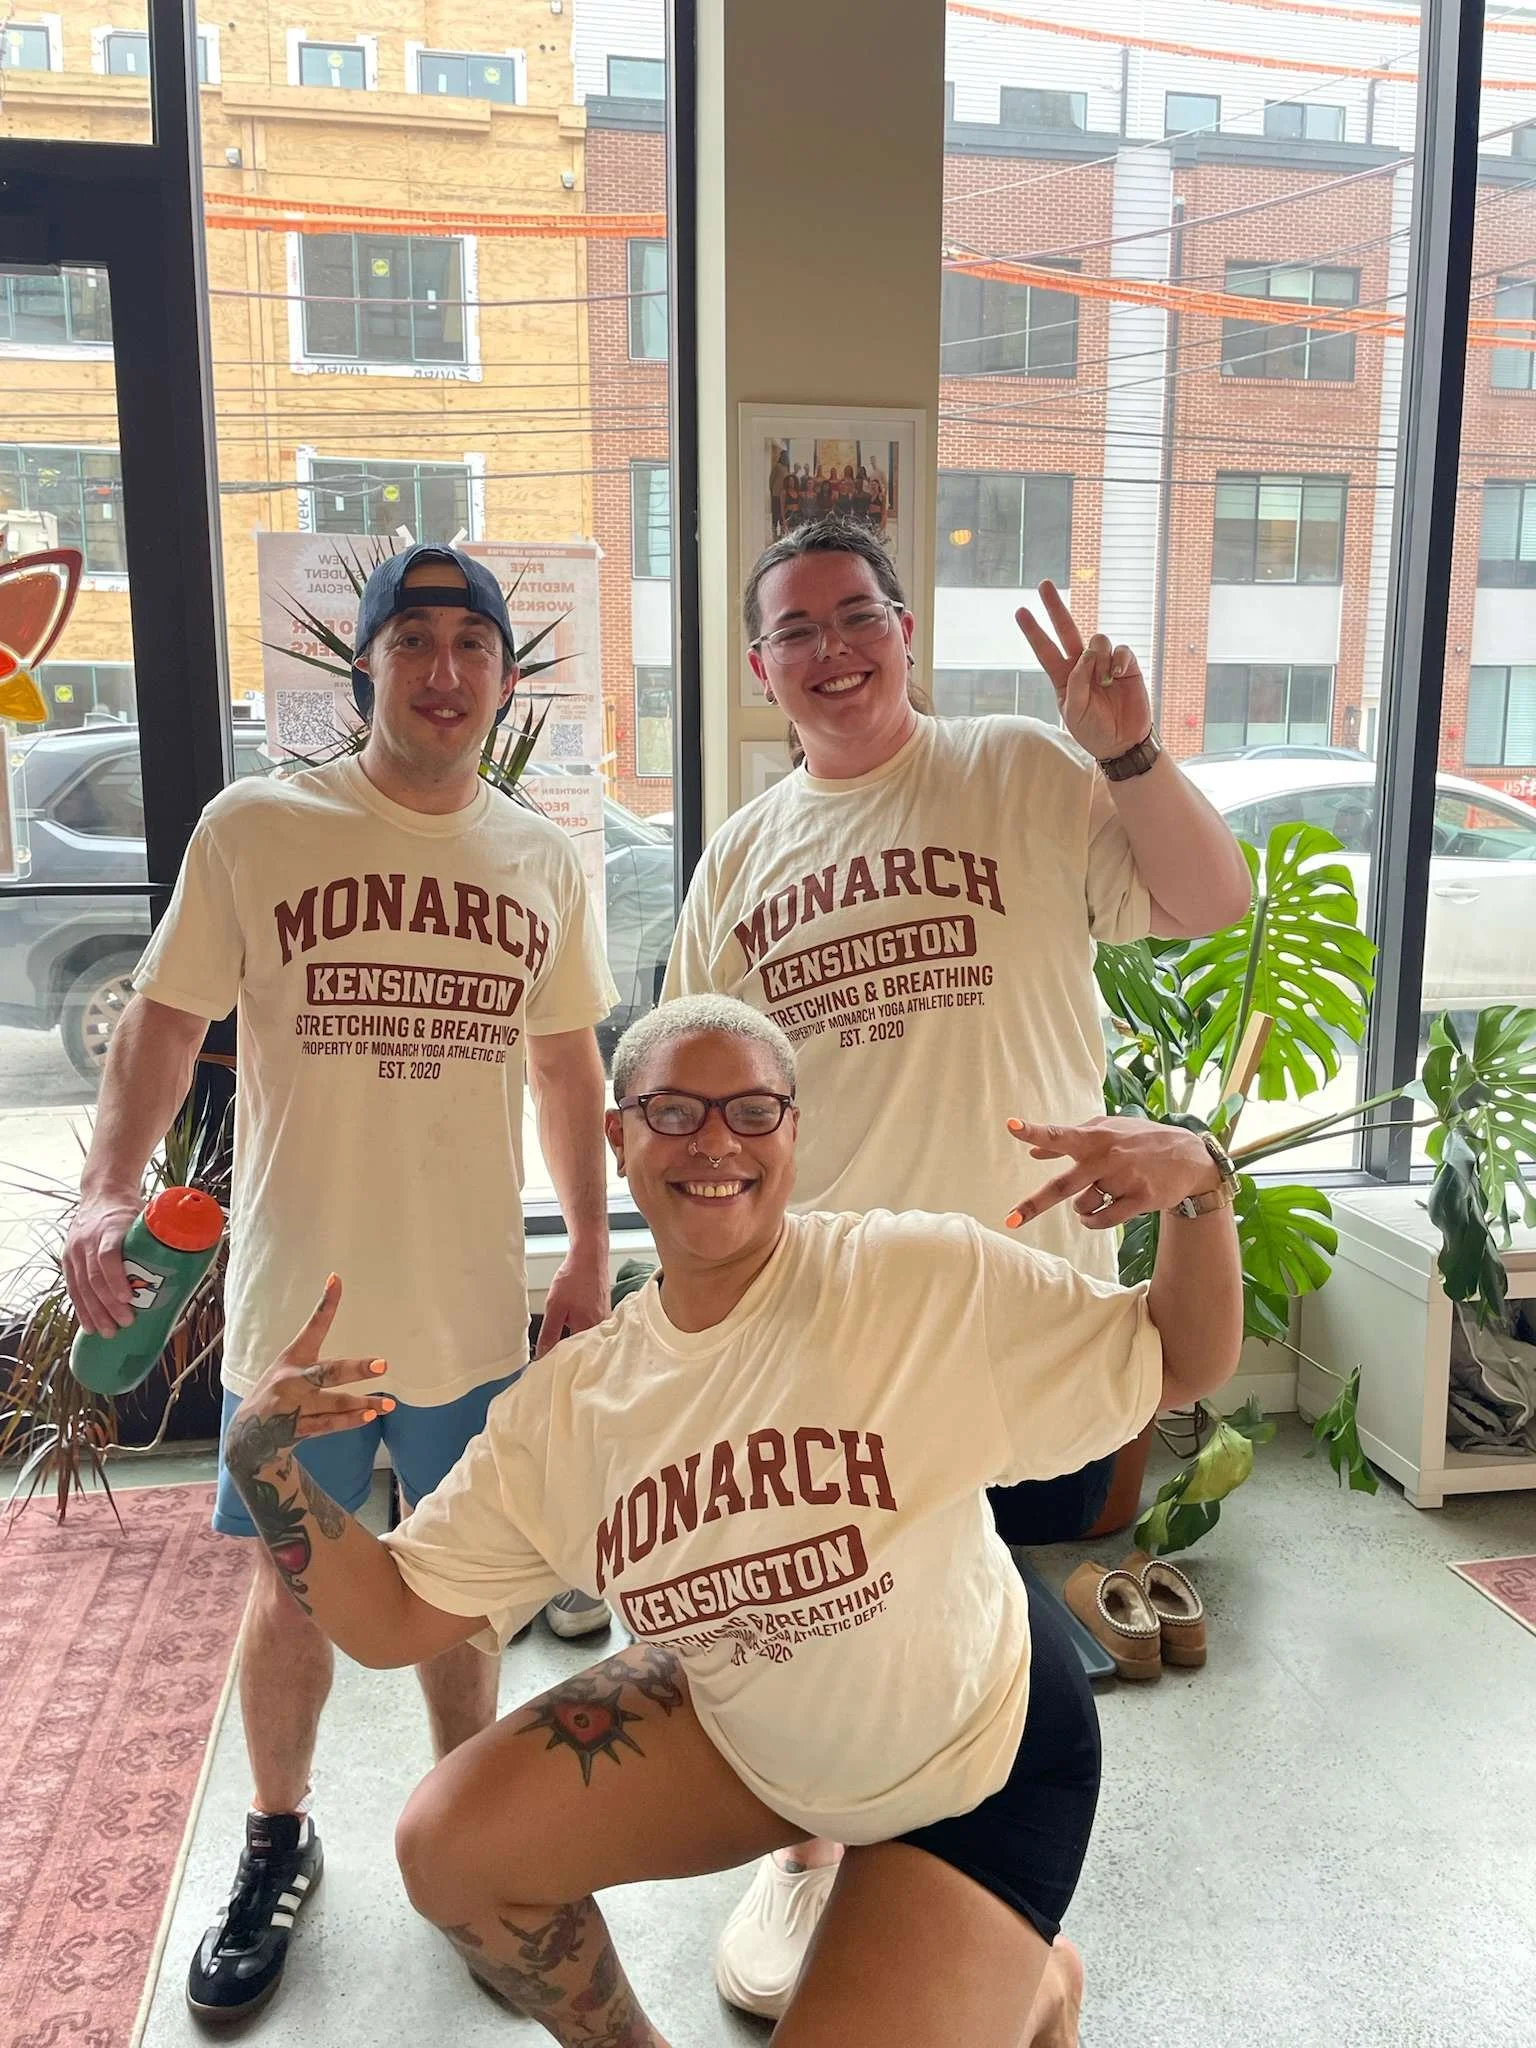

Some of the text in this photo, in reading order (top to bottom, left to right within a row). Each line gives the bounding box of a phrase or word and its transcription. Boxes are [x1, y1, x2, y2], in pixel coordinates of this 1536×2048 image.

[274, 873, 550, 978] MONARCH
[734, 846, 1007, 981] MONARCH
[766, 920, 968, 998] KENSINGTON
[312, 966, 516, 1013] KENSINGTON
[765, 964, 993, 1028] TRETCHING & BREATHING
[828, 1007, 876, 1030] MONARCH
[878, 1000, 906, 1020] YOGA
[907, 994, 955, 1014] ATHLETIC
[956, 991, 986, 1008] DEPT.
[296, 1014, 409, 1038] STRETCHING
[412, 1017, 426, 1038] &
[839, 1020, 905, 1049] EST. 2020
[355, 1041, 369, 1056] OF
[371, 1042, 420, 1058] MONARCH
[420, 1043, 445, 1059] YOGA
[446, 1045, 494, 1063] ATHLETIC
[378, 1060, 442, 1080] EST. 2020
[595, 1426, 898, 1594] MONARCH
[625, 1534, 855, 1632] KENSINGTON
[794, 1618, 852, 1644] ATHLETIC
[854, 1600, 887, 1627] DEPT.
